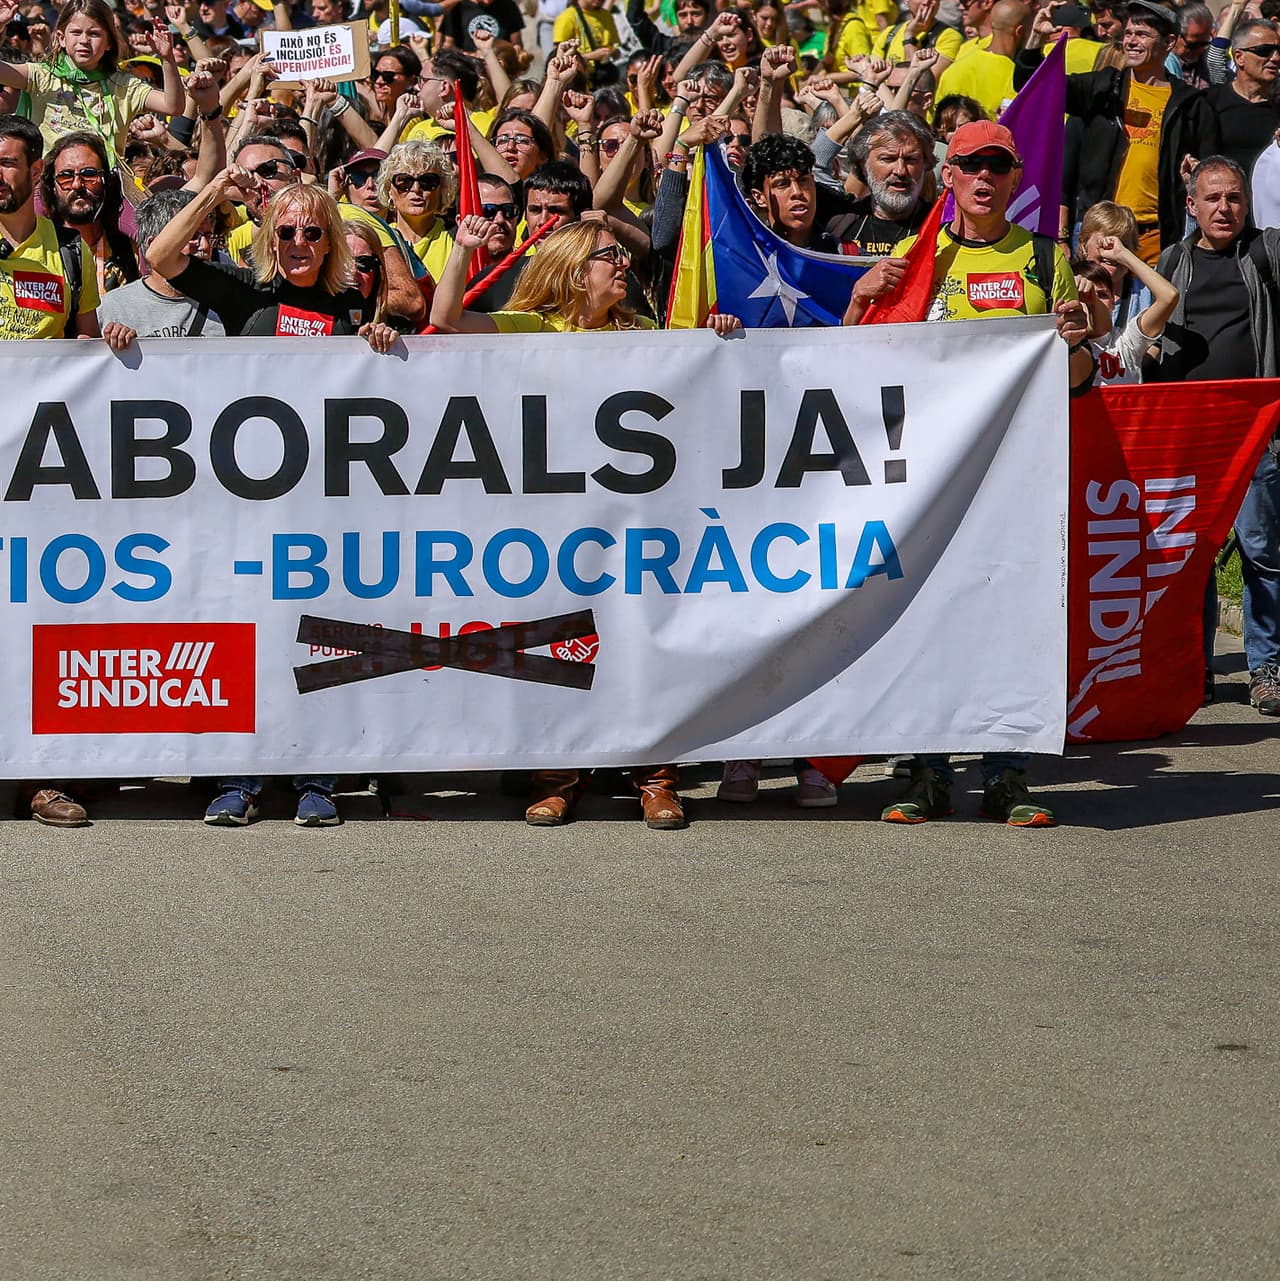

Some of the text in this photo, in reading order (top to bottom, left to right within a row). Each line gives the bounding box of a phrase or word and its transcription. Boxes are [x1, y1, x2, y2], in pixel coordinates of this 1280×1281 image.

[280, 31, 337, 49] AIXÒ NO ÉS
[329, 42, 342, 55] ÉS
[15, 280, 44, 291] INTER
[970, 282, 1000, 292] INTER
[15, 288, 62, 303] SINDICAL
[970, 289, 1021, 301] SINDICAL
[281, 315, 311, 328] INTER
[722, 386, 907, 489] JA!
[233, 508, 904, 600] -BUROCRÀCIA
[58, 649, 162, 677] INTER
[57, 677, 229, 708] SINDICAL
